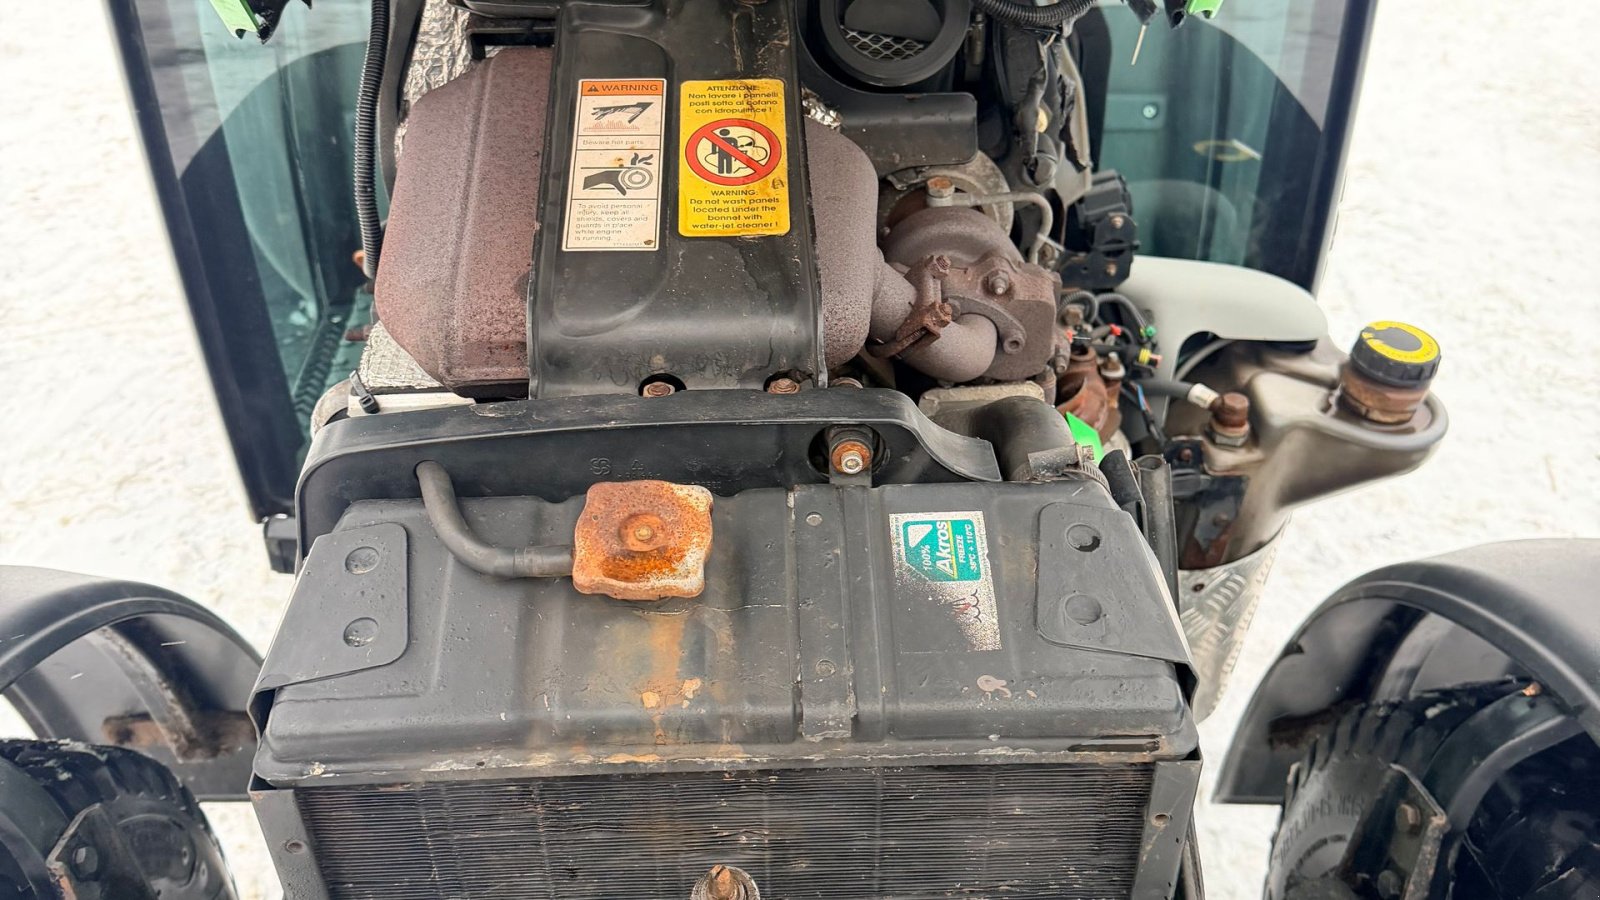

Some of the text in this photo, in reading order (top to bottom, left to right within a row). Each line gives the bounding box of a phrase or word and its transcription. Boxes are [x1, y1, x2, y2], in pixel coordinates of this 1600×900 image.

[601, 84, 658, 92] WARNING
[748, 197, 780, 205] panels
[692, 222, 734, 230] water-jet
[920, 543, 932, 571] 100%
[935, 520, 956, 577] Akros
[955, 534, 967, 564] FREEZE
